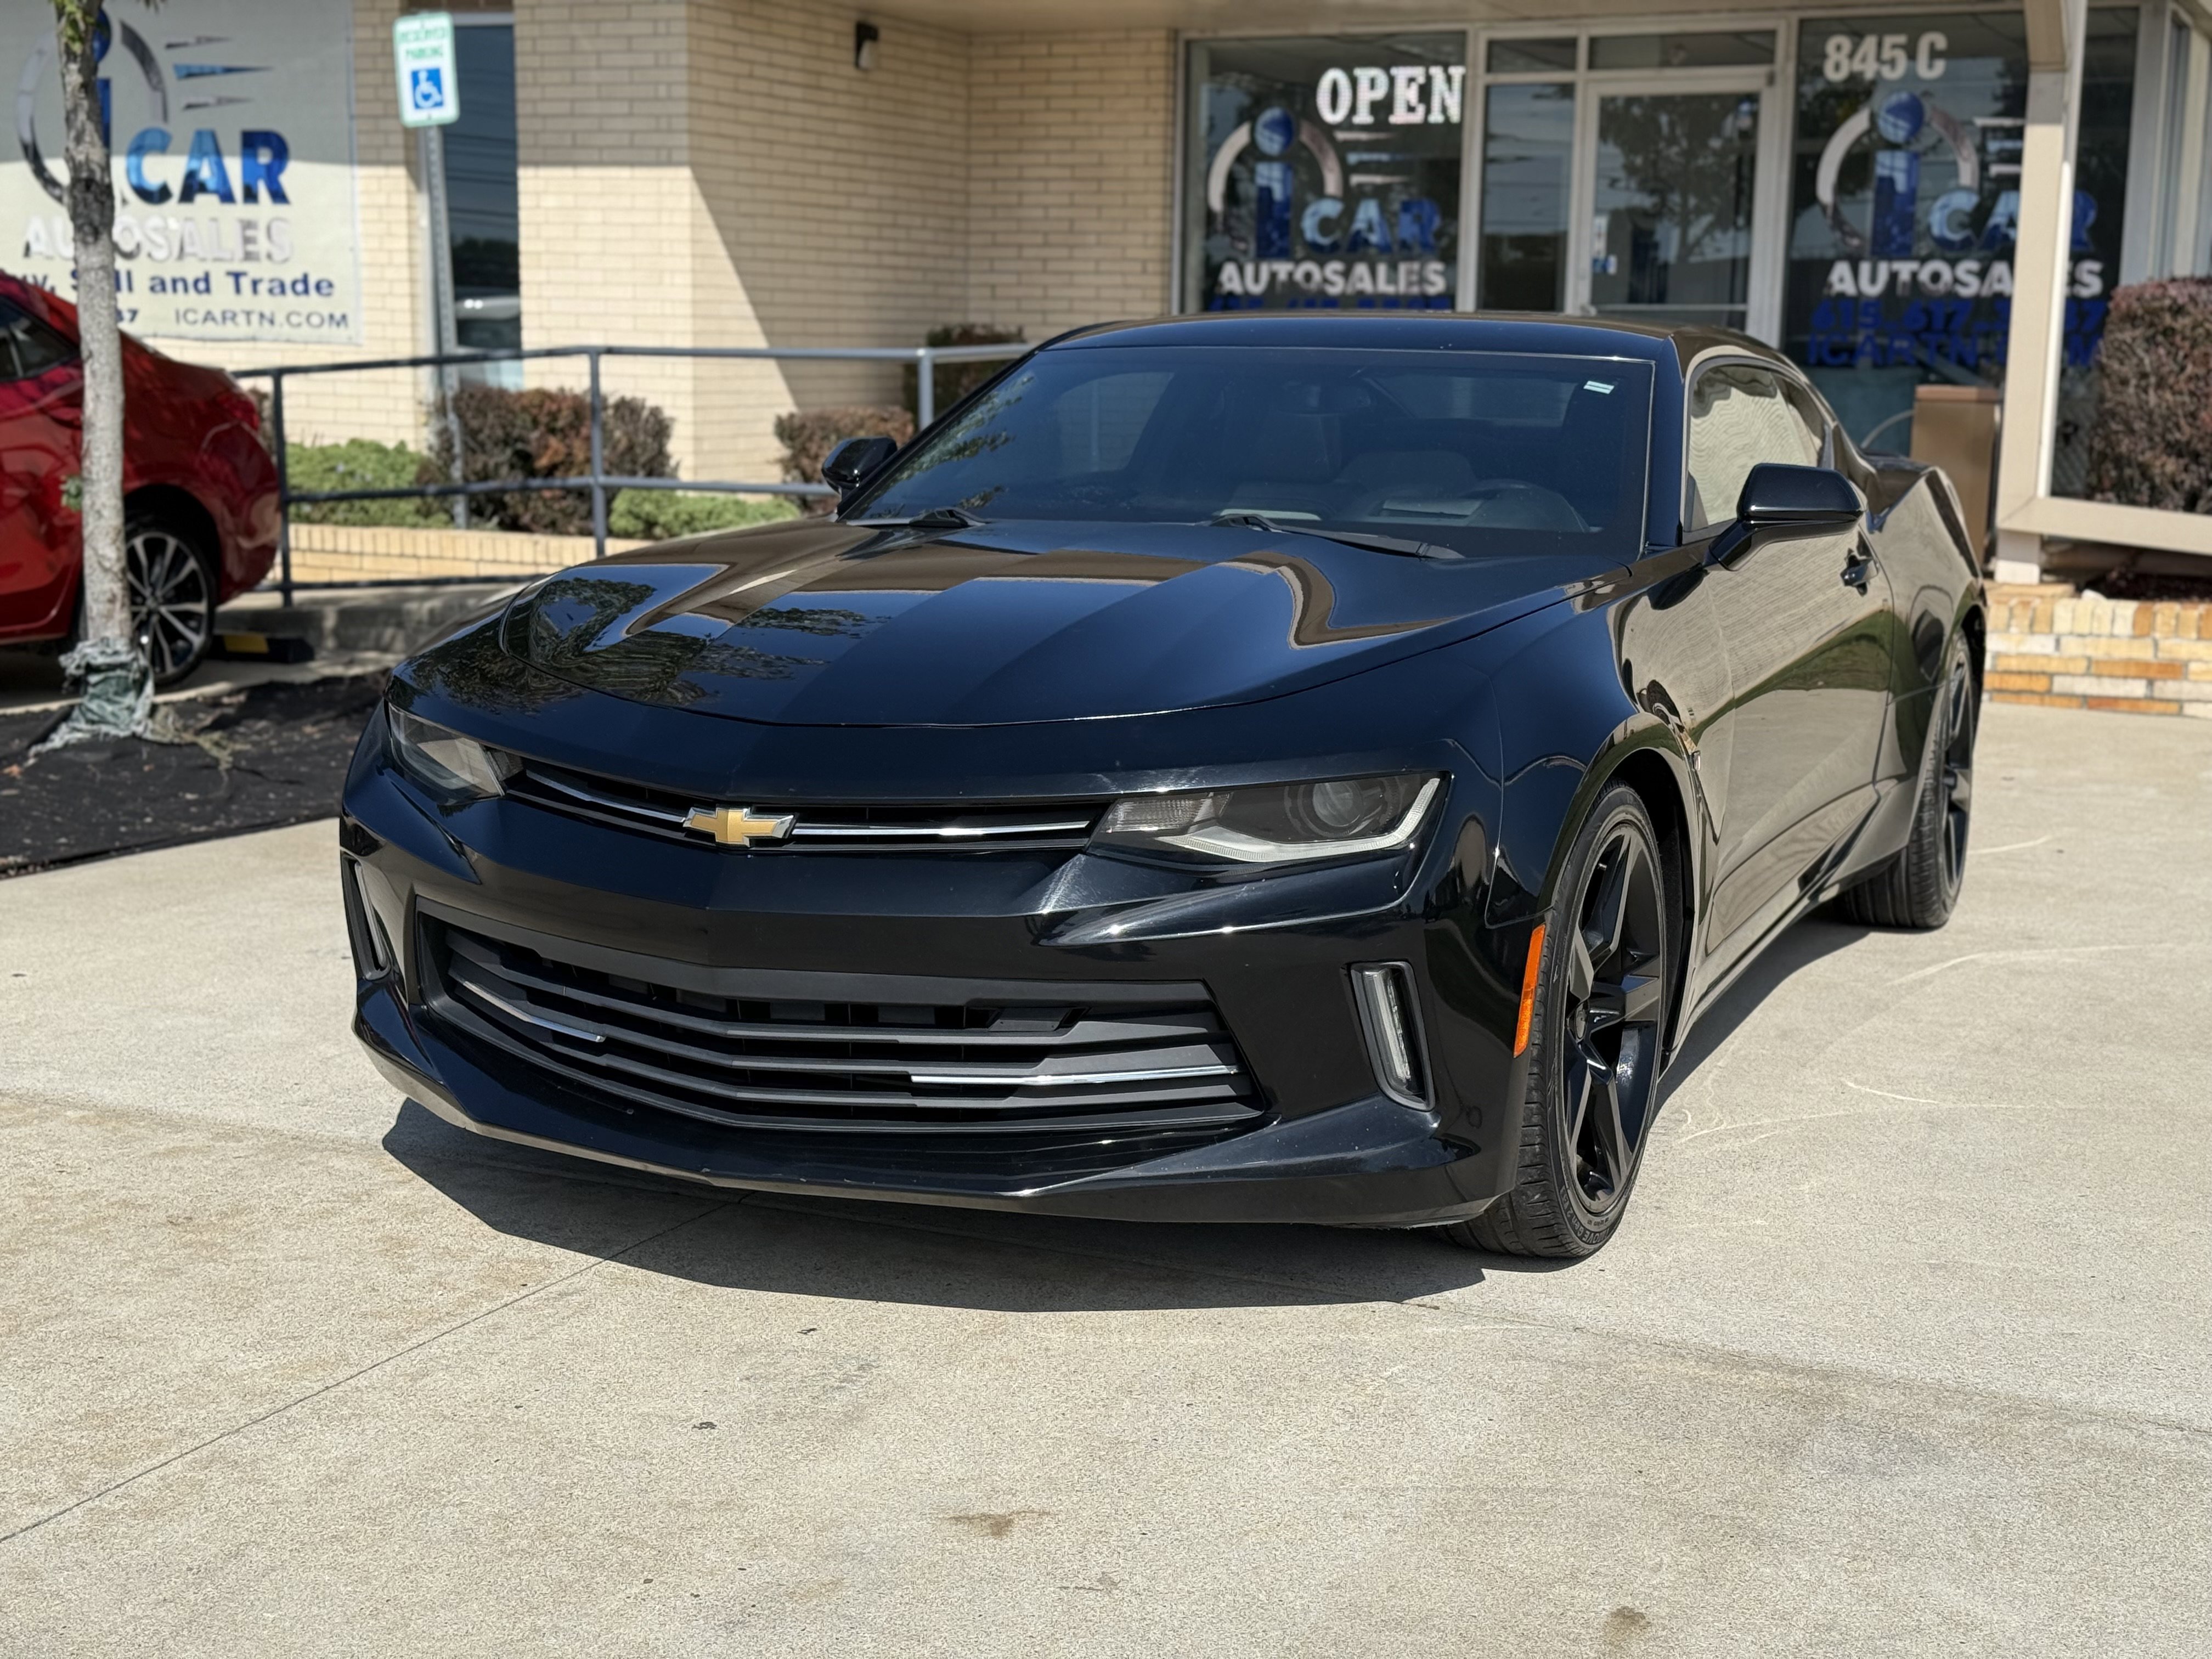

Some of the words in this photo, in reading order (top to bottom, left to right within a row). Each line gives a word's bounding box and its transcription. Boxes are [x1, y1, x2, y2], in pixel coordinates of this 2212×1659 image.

[1823, 33, 1908, 82] 845
[1915, 31, 1948, 80] C
[1317, 66, 1466, 125] OPEN
[24, 216, 292, 262] AUOSALES
[149, 271, 212, 294] and
[225, 270, 335, 296] Trade
[1215, 259, 1447, 296] AUTOSALES
[1825, 259, 2104, 298] AUTOSAS
[175, 308, 349, 328] ICARTN.COM
